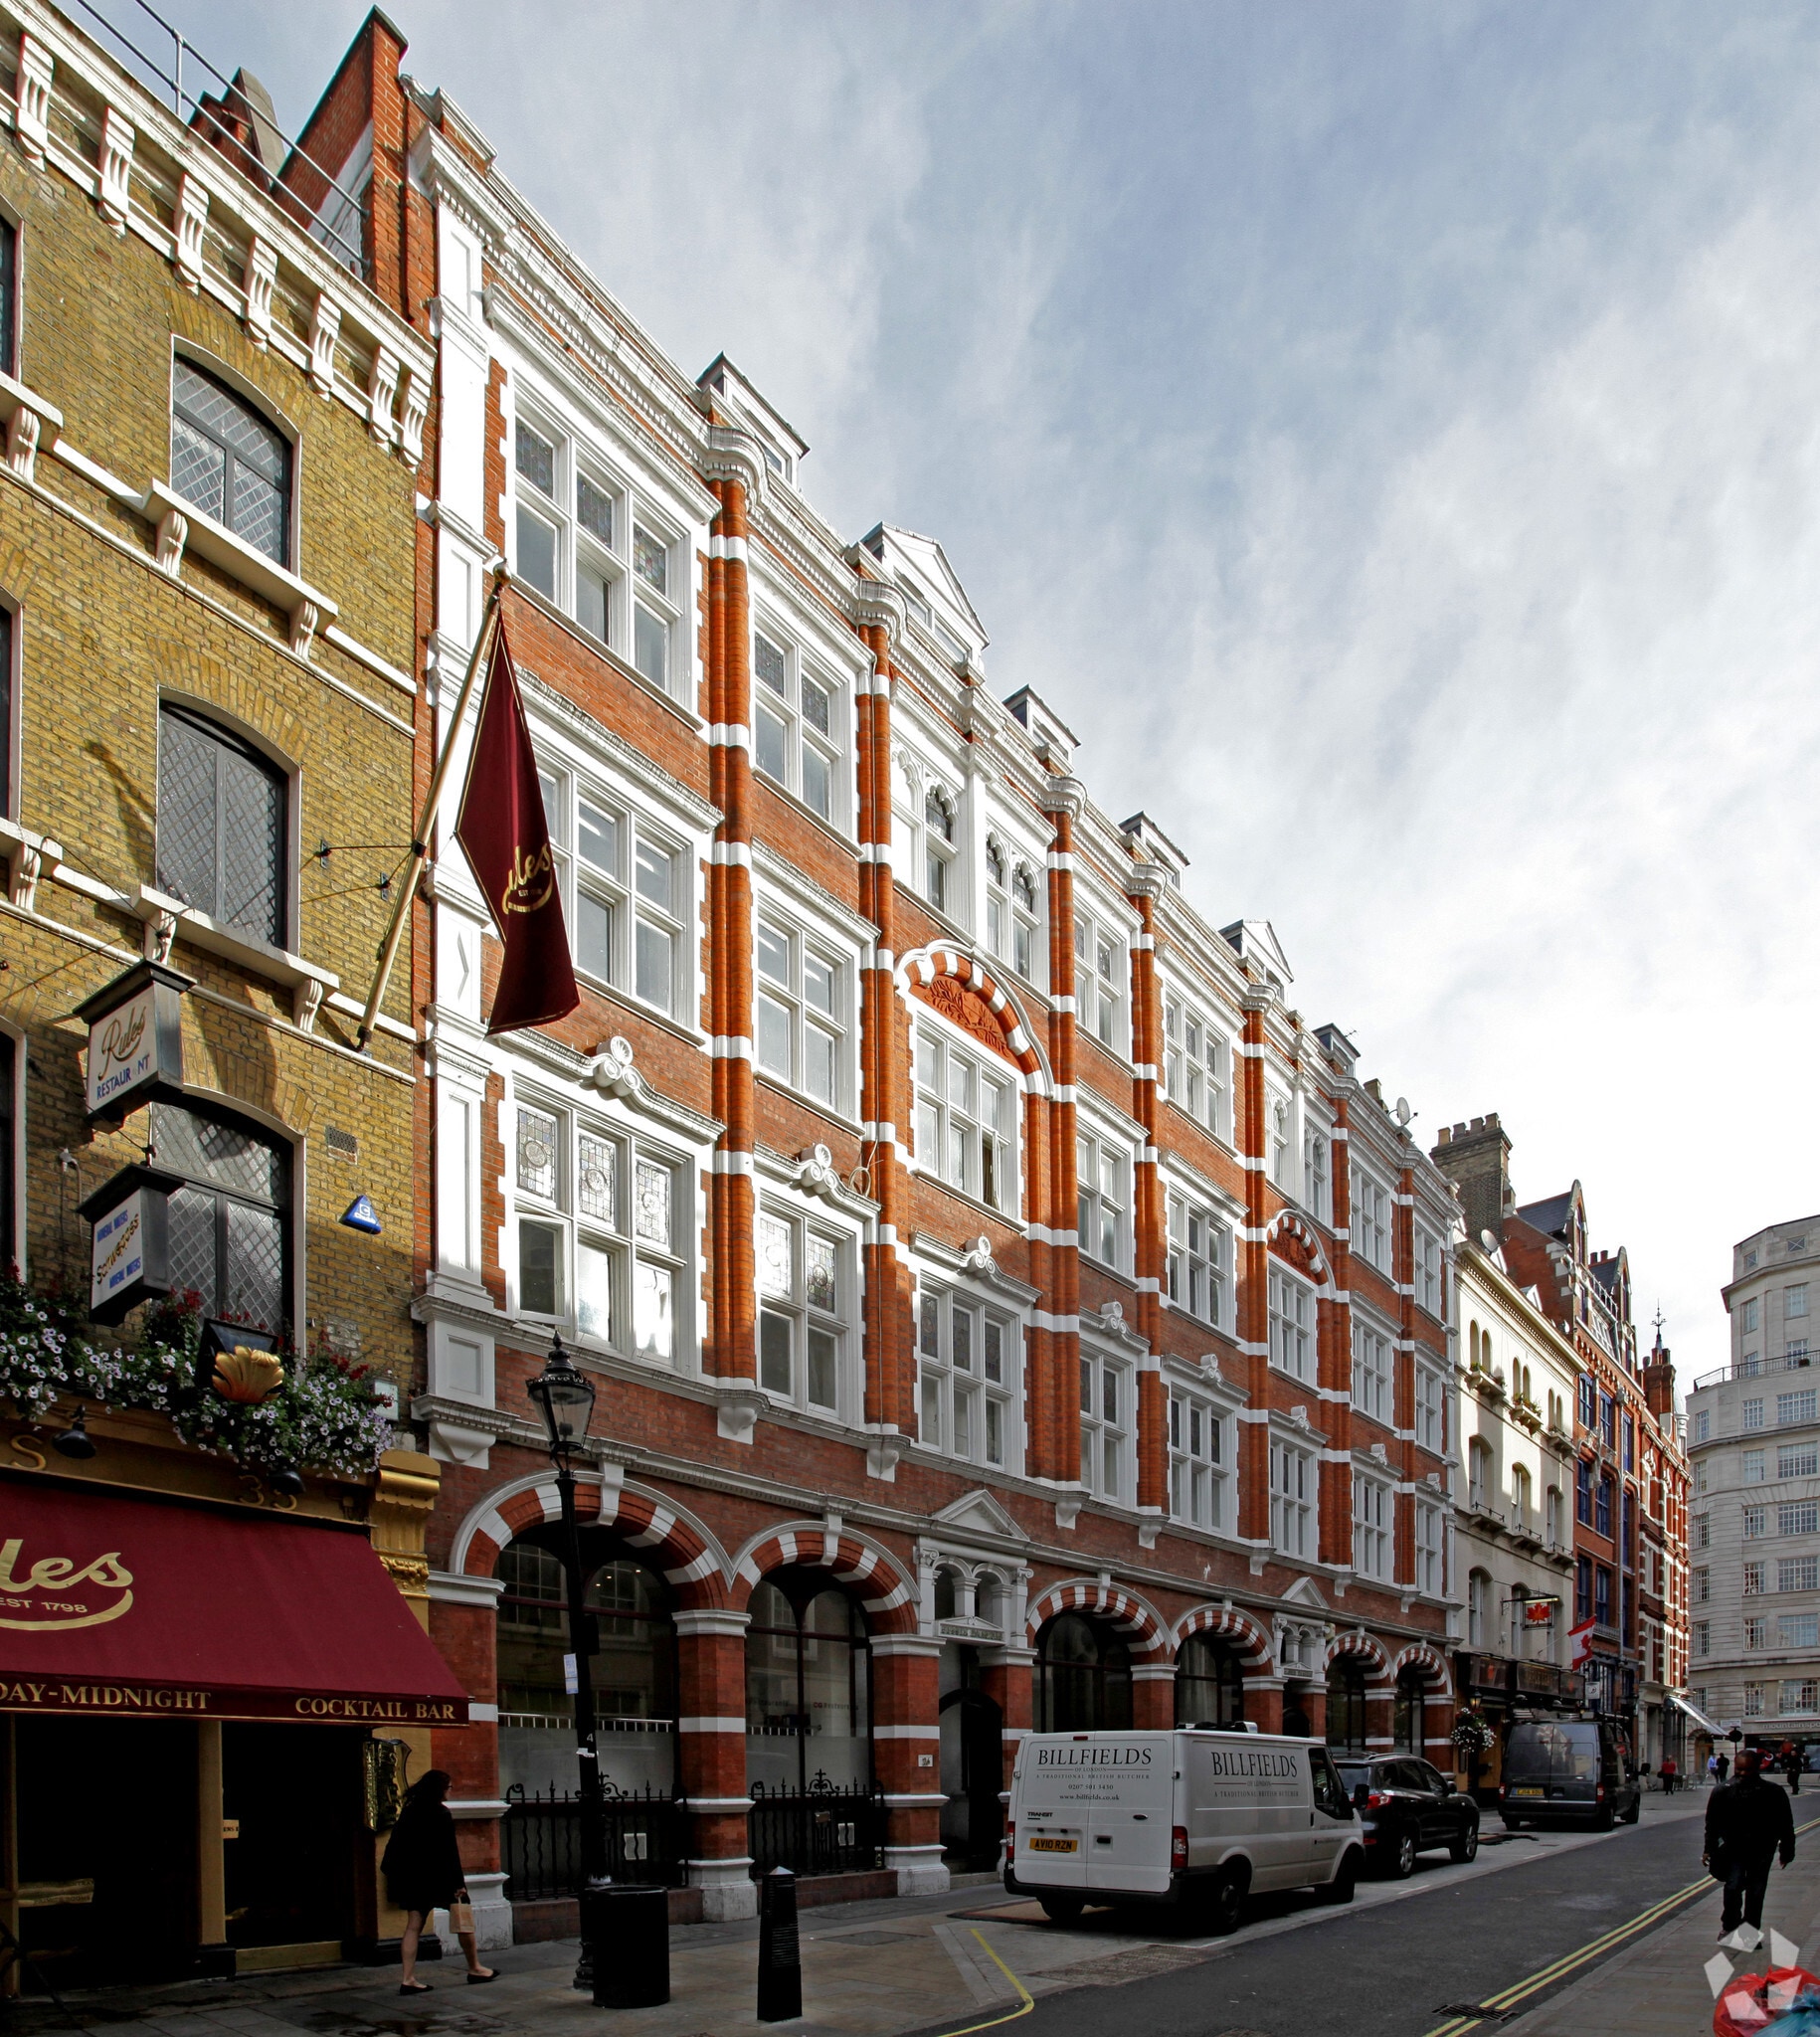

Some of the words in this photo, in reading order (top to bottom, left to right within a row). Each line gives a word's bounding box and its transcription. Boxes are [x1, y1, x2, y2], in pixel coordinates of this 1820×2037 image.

[97, 1006, 147, 1081] Rules
[96, 1054, 150, 1101] RESTAURNT
[41, 1601, 89, 1613] 1798
[295, 1697, 408, 1719] COCKTAIL
[416, 1702, 455, 1720] BAR
[586, 1733, 594, 1743] 4
[1037, 1748, 1152, 1765] BILLFIELDS
[1210, 1752, 1298, 1778] BILLFIELDS
[1055, 1840, 1073, 1851] RZN
